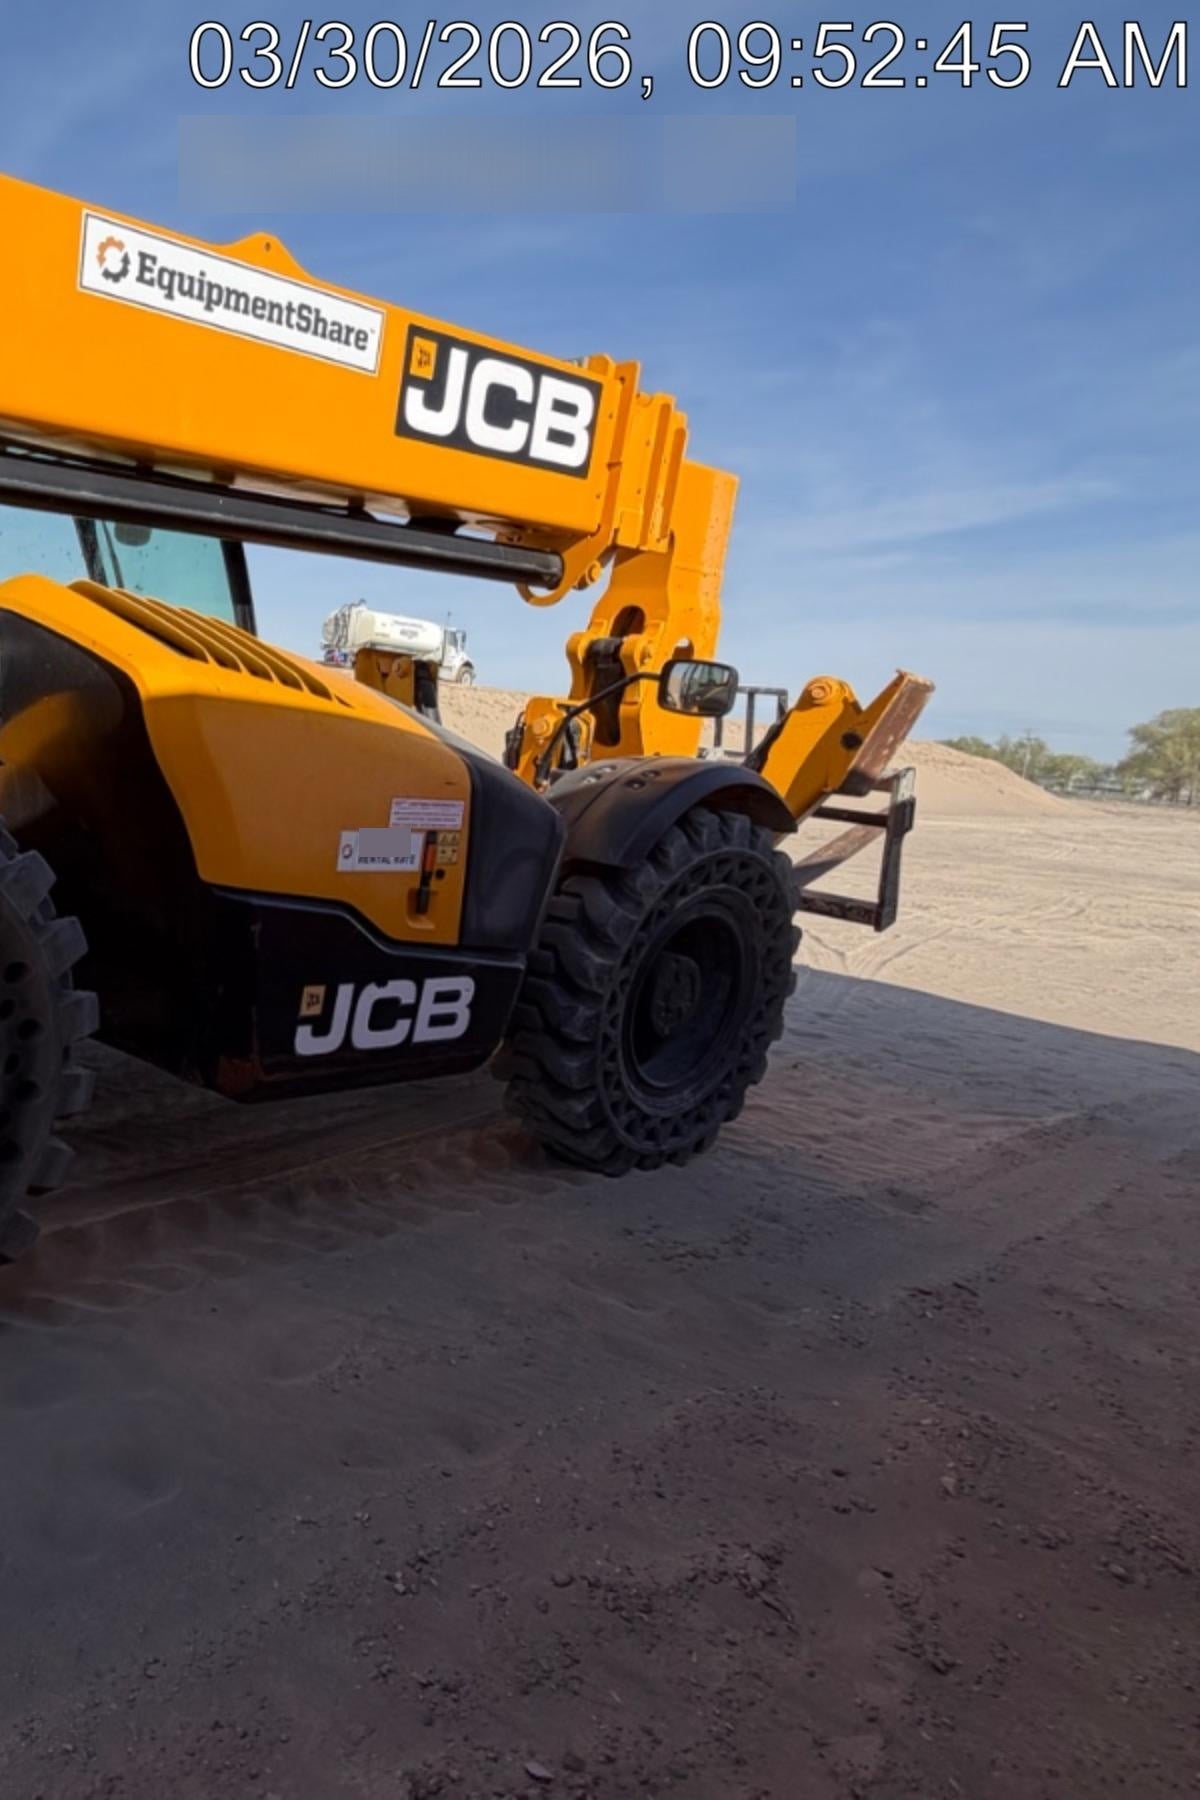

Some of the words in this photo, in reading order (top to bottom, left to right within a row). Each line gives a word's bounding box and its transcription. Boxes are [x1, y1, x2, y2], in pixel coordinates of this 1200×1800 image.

[135, 250, 370, 351] EquipmentShare
[404, 347, 595, 468] JCB
[294, 976, 475, 1056] JCB
